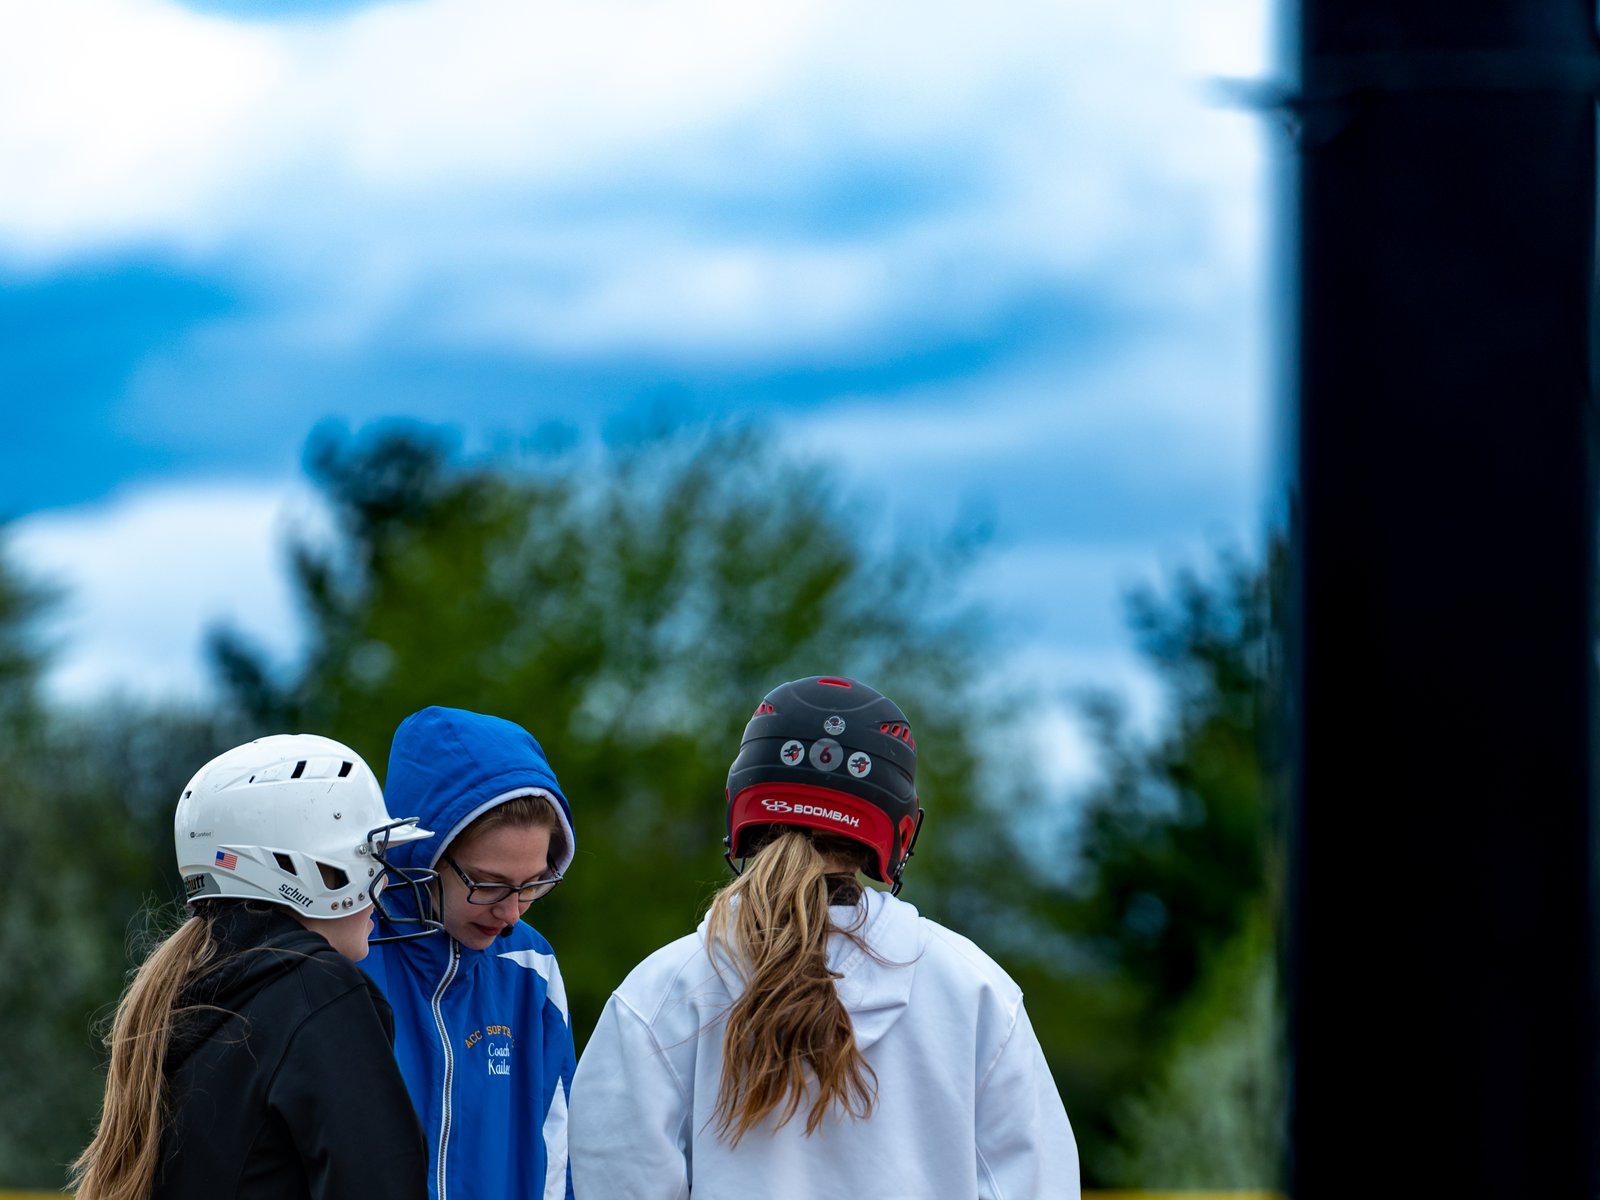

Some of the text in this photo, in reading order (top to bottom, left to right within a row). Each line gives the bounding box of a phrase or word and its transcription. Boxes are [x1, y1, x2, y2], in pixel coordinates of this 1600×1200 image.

[819, 745, 832, 764] 6
[793, 804, 860, 828] BOOMBAH
[279, 883, 313, 907] schutt
[465, 1030, 483, 1049] ACC
[488, 1042, 510, 1057] Coach
